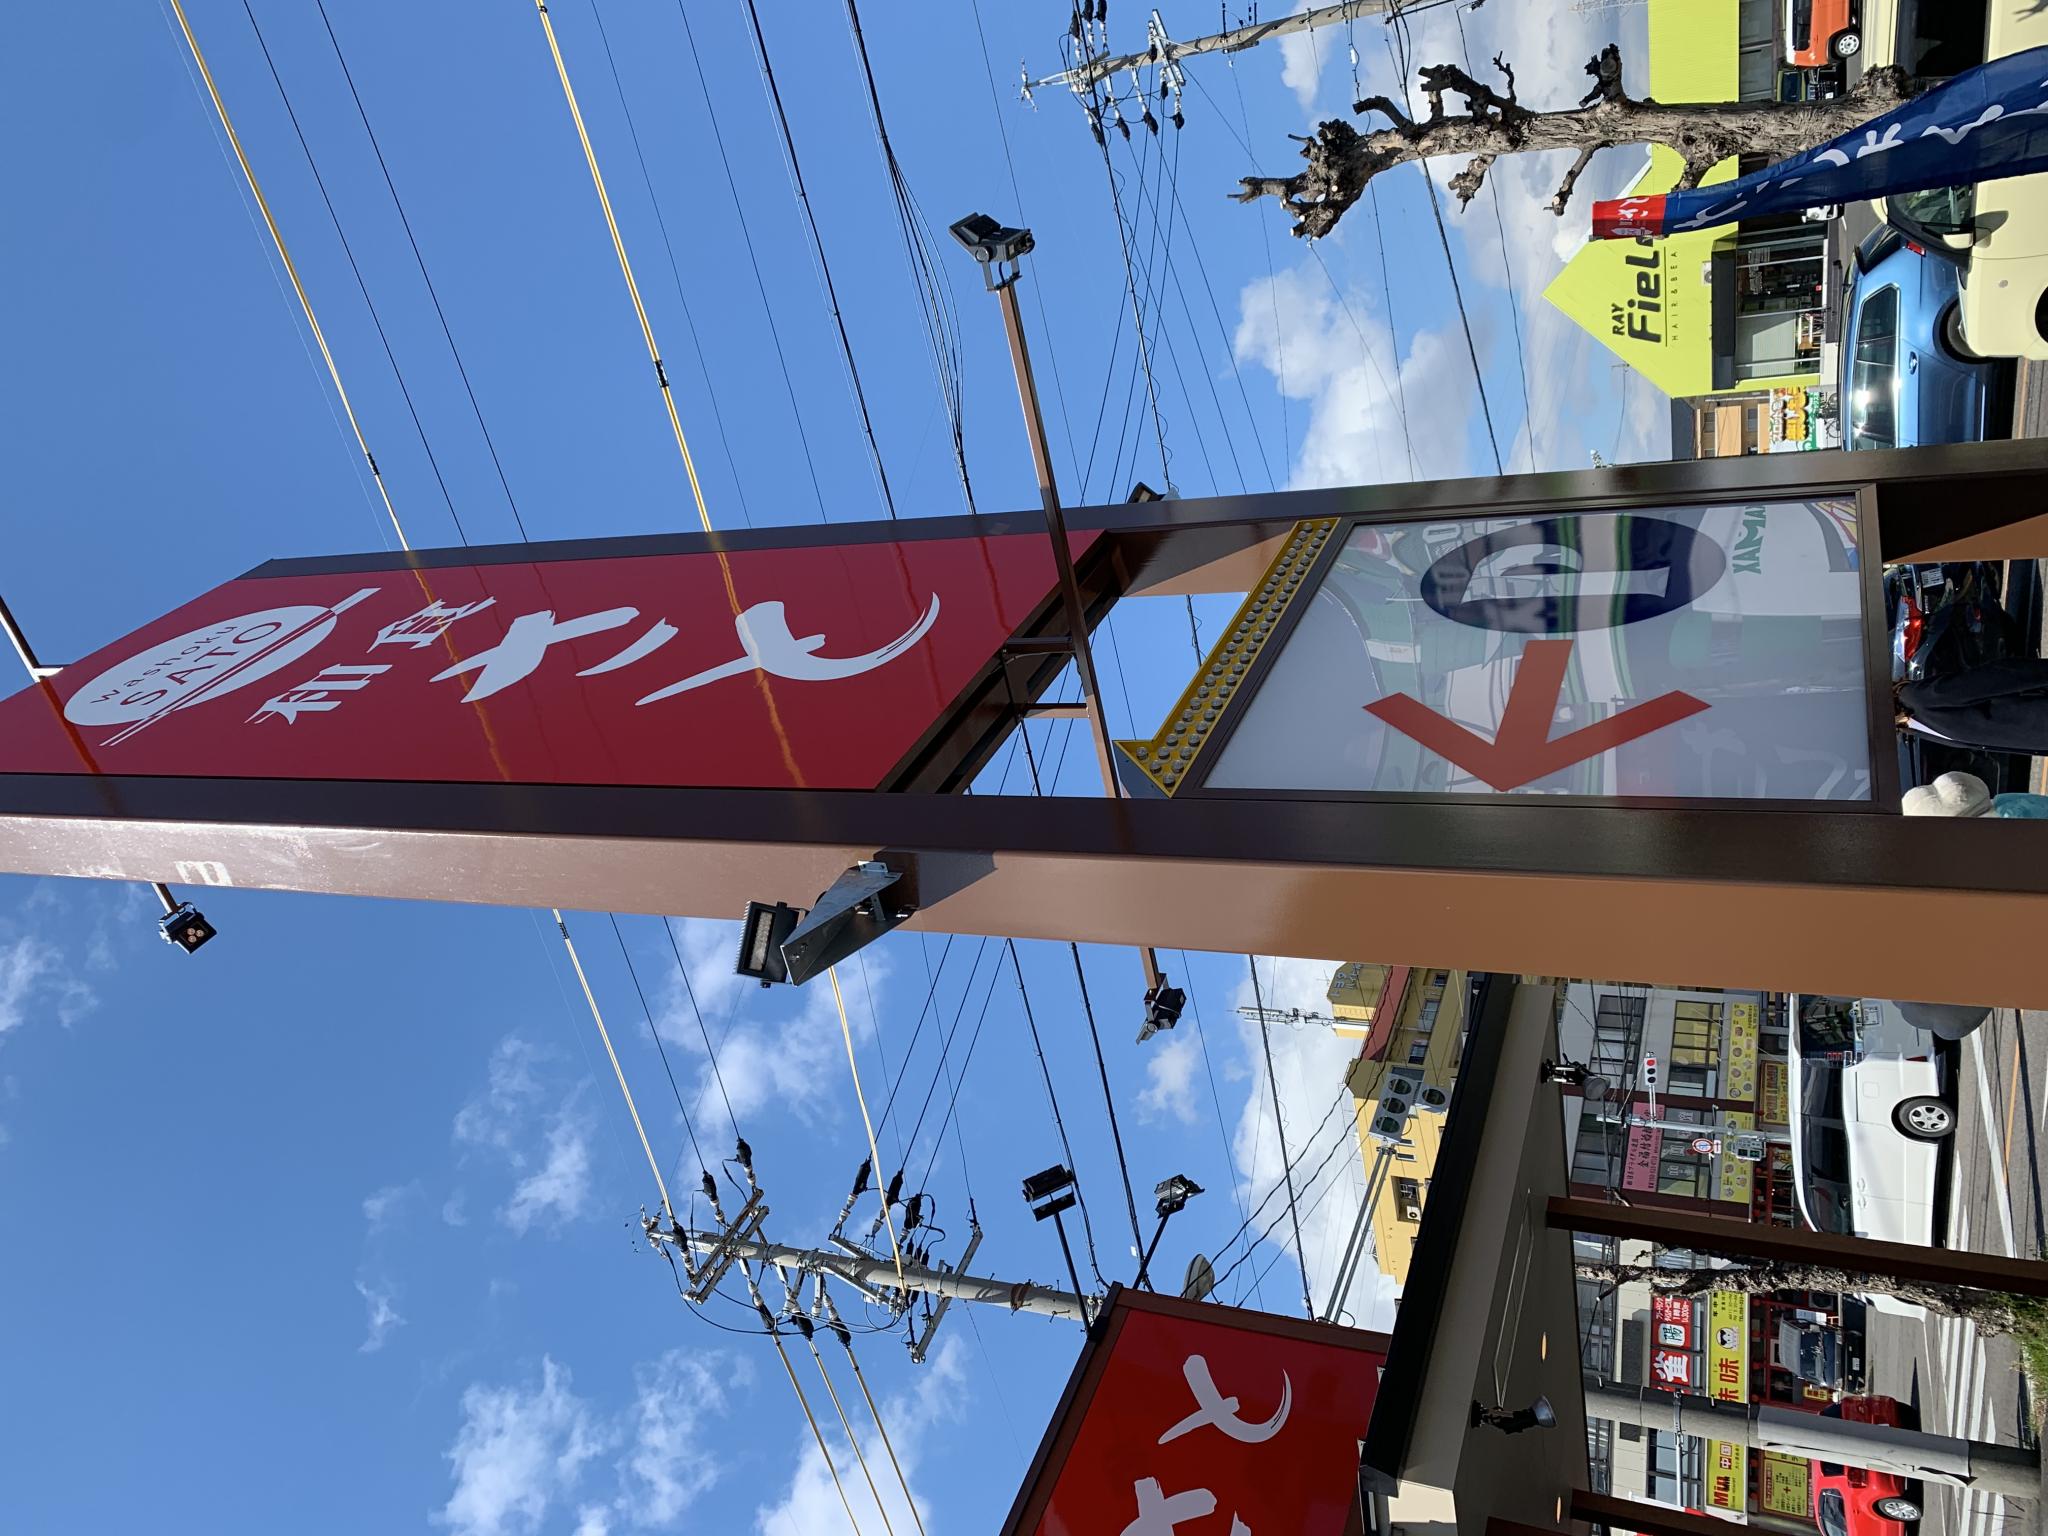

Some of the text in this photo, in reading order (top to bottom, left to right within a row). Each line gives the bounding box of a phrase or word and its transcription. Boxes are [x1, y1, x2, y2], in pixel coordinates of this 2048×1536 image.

[1611, 302, 1625, 336] RAY
[1459, 542, 1672, 603] P
[119, 621, 283, 706] SATO
[243, 600, 497, 726] 和食
[428, 593, 942, 703] さと
[1653, 1350, 1688, 1393] 雀
[1713, 1476, 1729, 1507] Min
